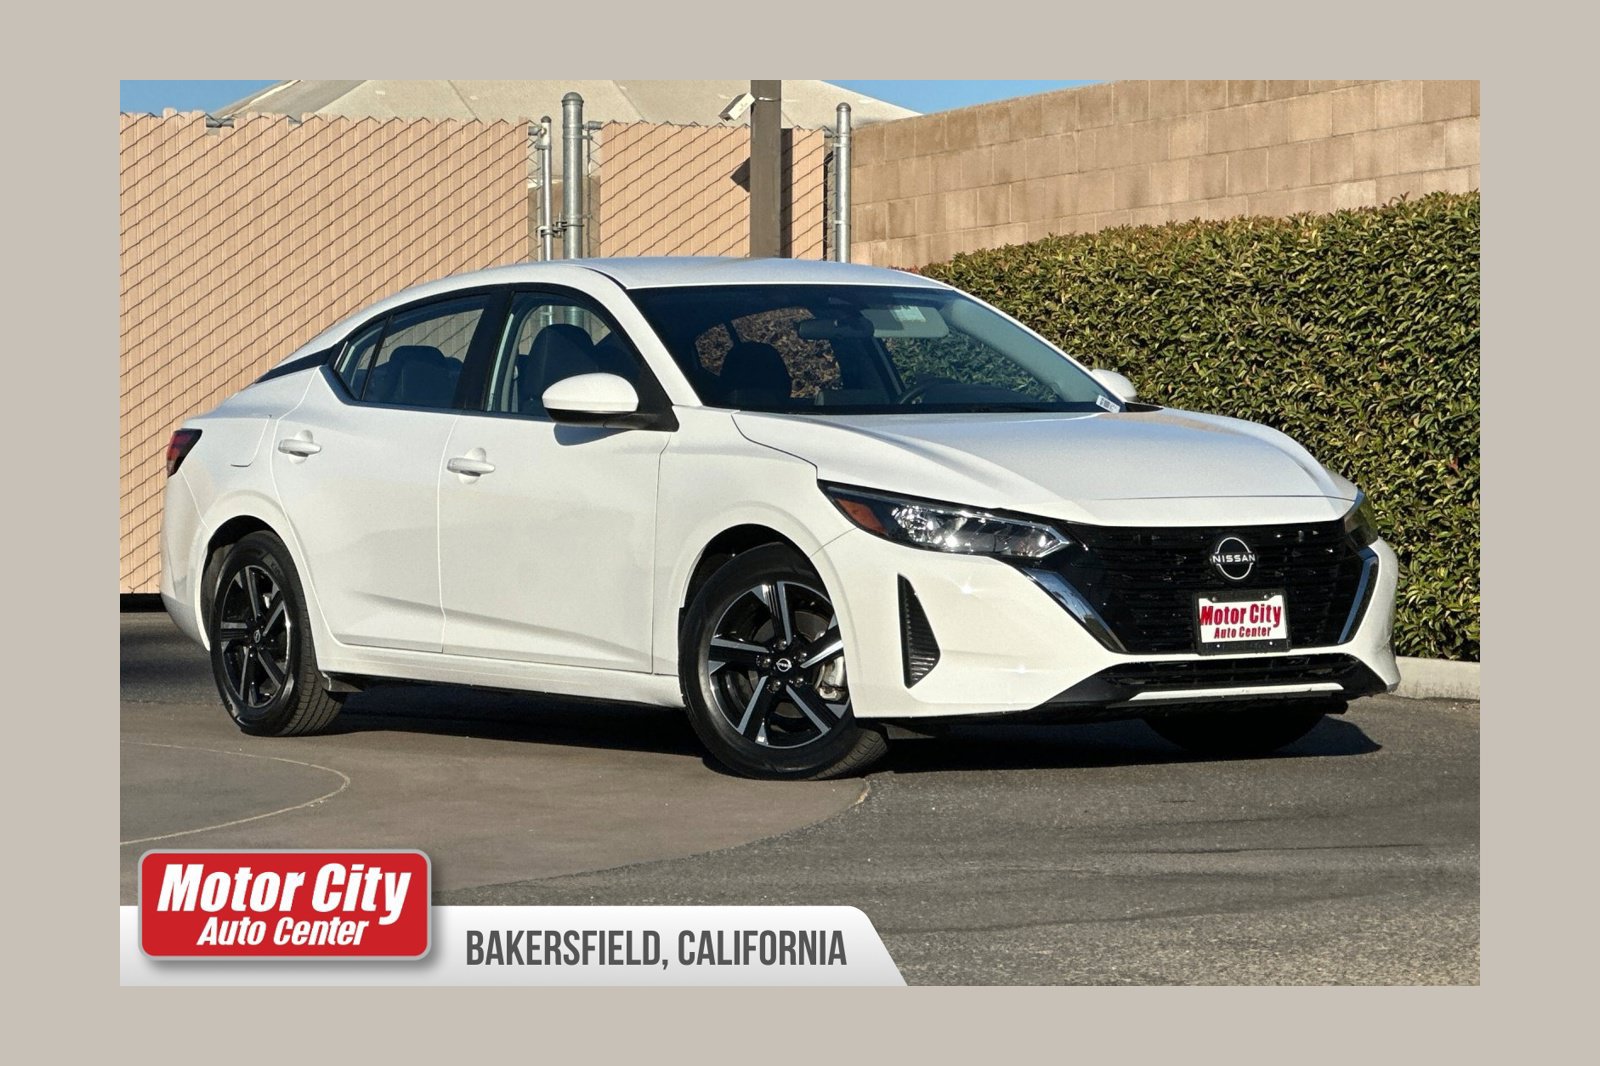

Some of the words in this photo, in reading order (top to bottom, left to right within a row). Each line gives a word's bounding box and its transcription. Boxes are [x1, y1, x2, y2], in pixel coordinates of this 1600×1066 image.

[1212, 554, 1256, 563] NISSAN
[1200, 605, 1246, 626] Motor
[1249, 603, 1281, 628] City
[1214, 627, 1237, 639] Auto
[1238, 626, 1272, 637] Center
